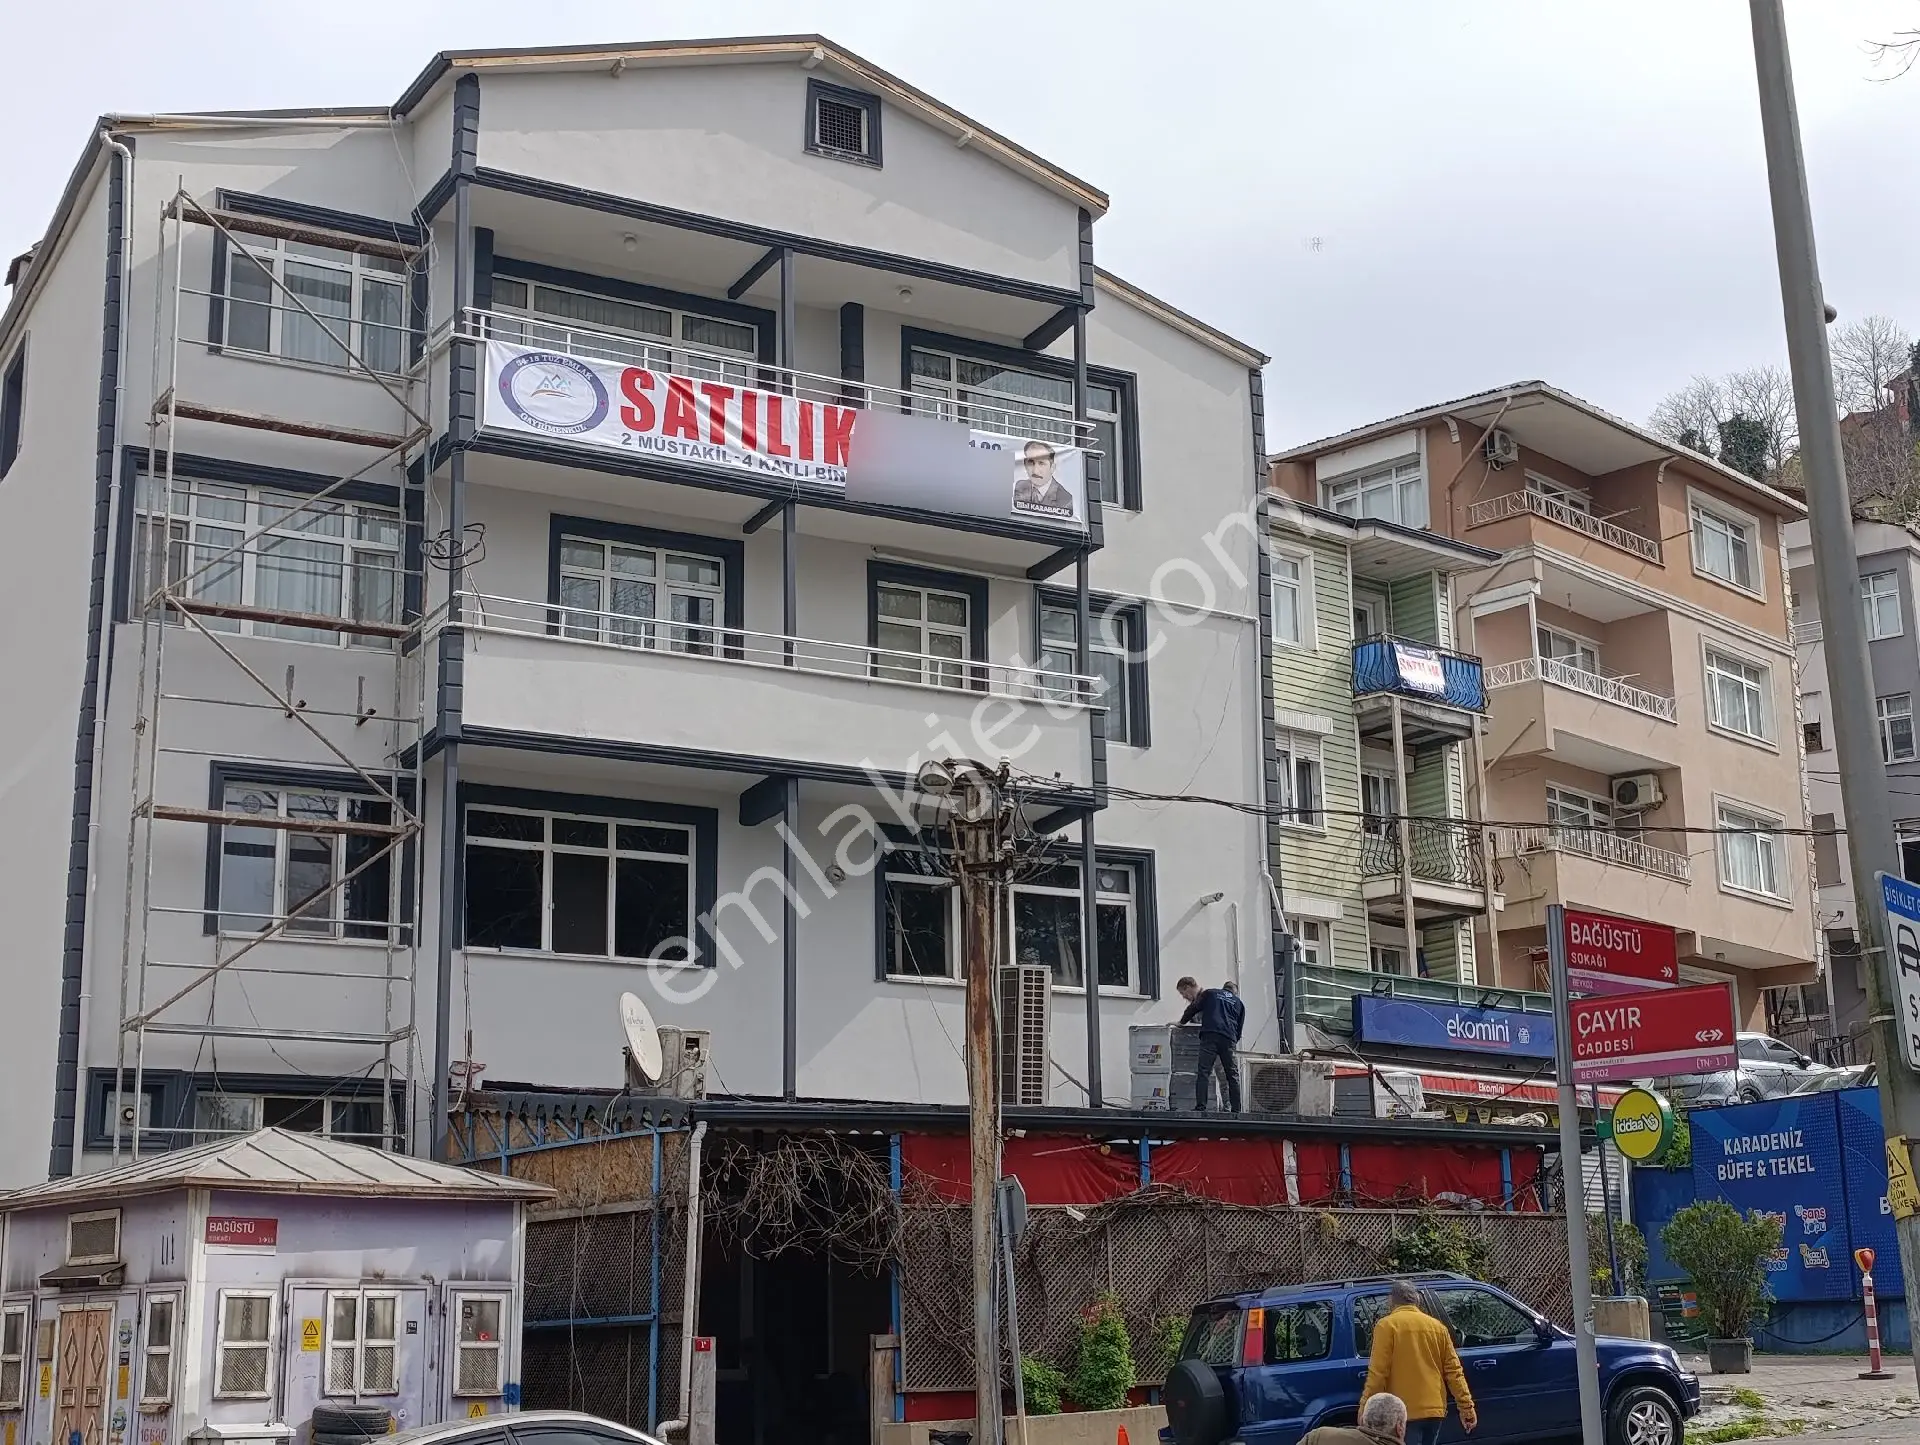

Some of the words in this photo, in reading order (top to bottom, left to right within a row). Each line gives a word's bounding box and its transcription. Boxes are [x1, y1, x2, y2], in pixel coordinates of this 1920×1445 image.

[561, 357, 592, 380] EMLAK
[620, 366, 857, 468] SATILIK
[621, 432, 632, 446] 2
[758, 457, 809, 478] KATLI
[1031, 501, 1070, 516] KARABACAK
[1884, 884, 1915, 912] BİSİKLET
[1571, 922, 1641, 954] BAĞÜSTÜ
[1571, 952, 1607, 968] SOKAĞI
[1572, 978, 1593, 989] BEYKOZ
[1446, 1013, 1510, 1042] ekomini
[1577, 1007, 1641, 1039] ÇAYIR
[1577, 1036, 1634, 1056] CADDESİ
[1581, 1068, 1609, 1080] BEYKOZ
[1478, 1082, 1505, 1095] Ekomini
[1616, 1117, 1644, 1134] iddaa
[1723, 1126, 1804, 1156] KARADENİZ
[1717, 1158, 1754, 1181] BÜFE
[1757, 1161, 1767, 1178] &
[1769, 1155, 1815, 1176] TEKEL
[209, 1220, 255, 1234] BAĞÜSTÜ
